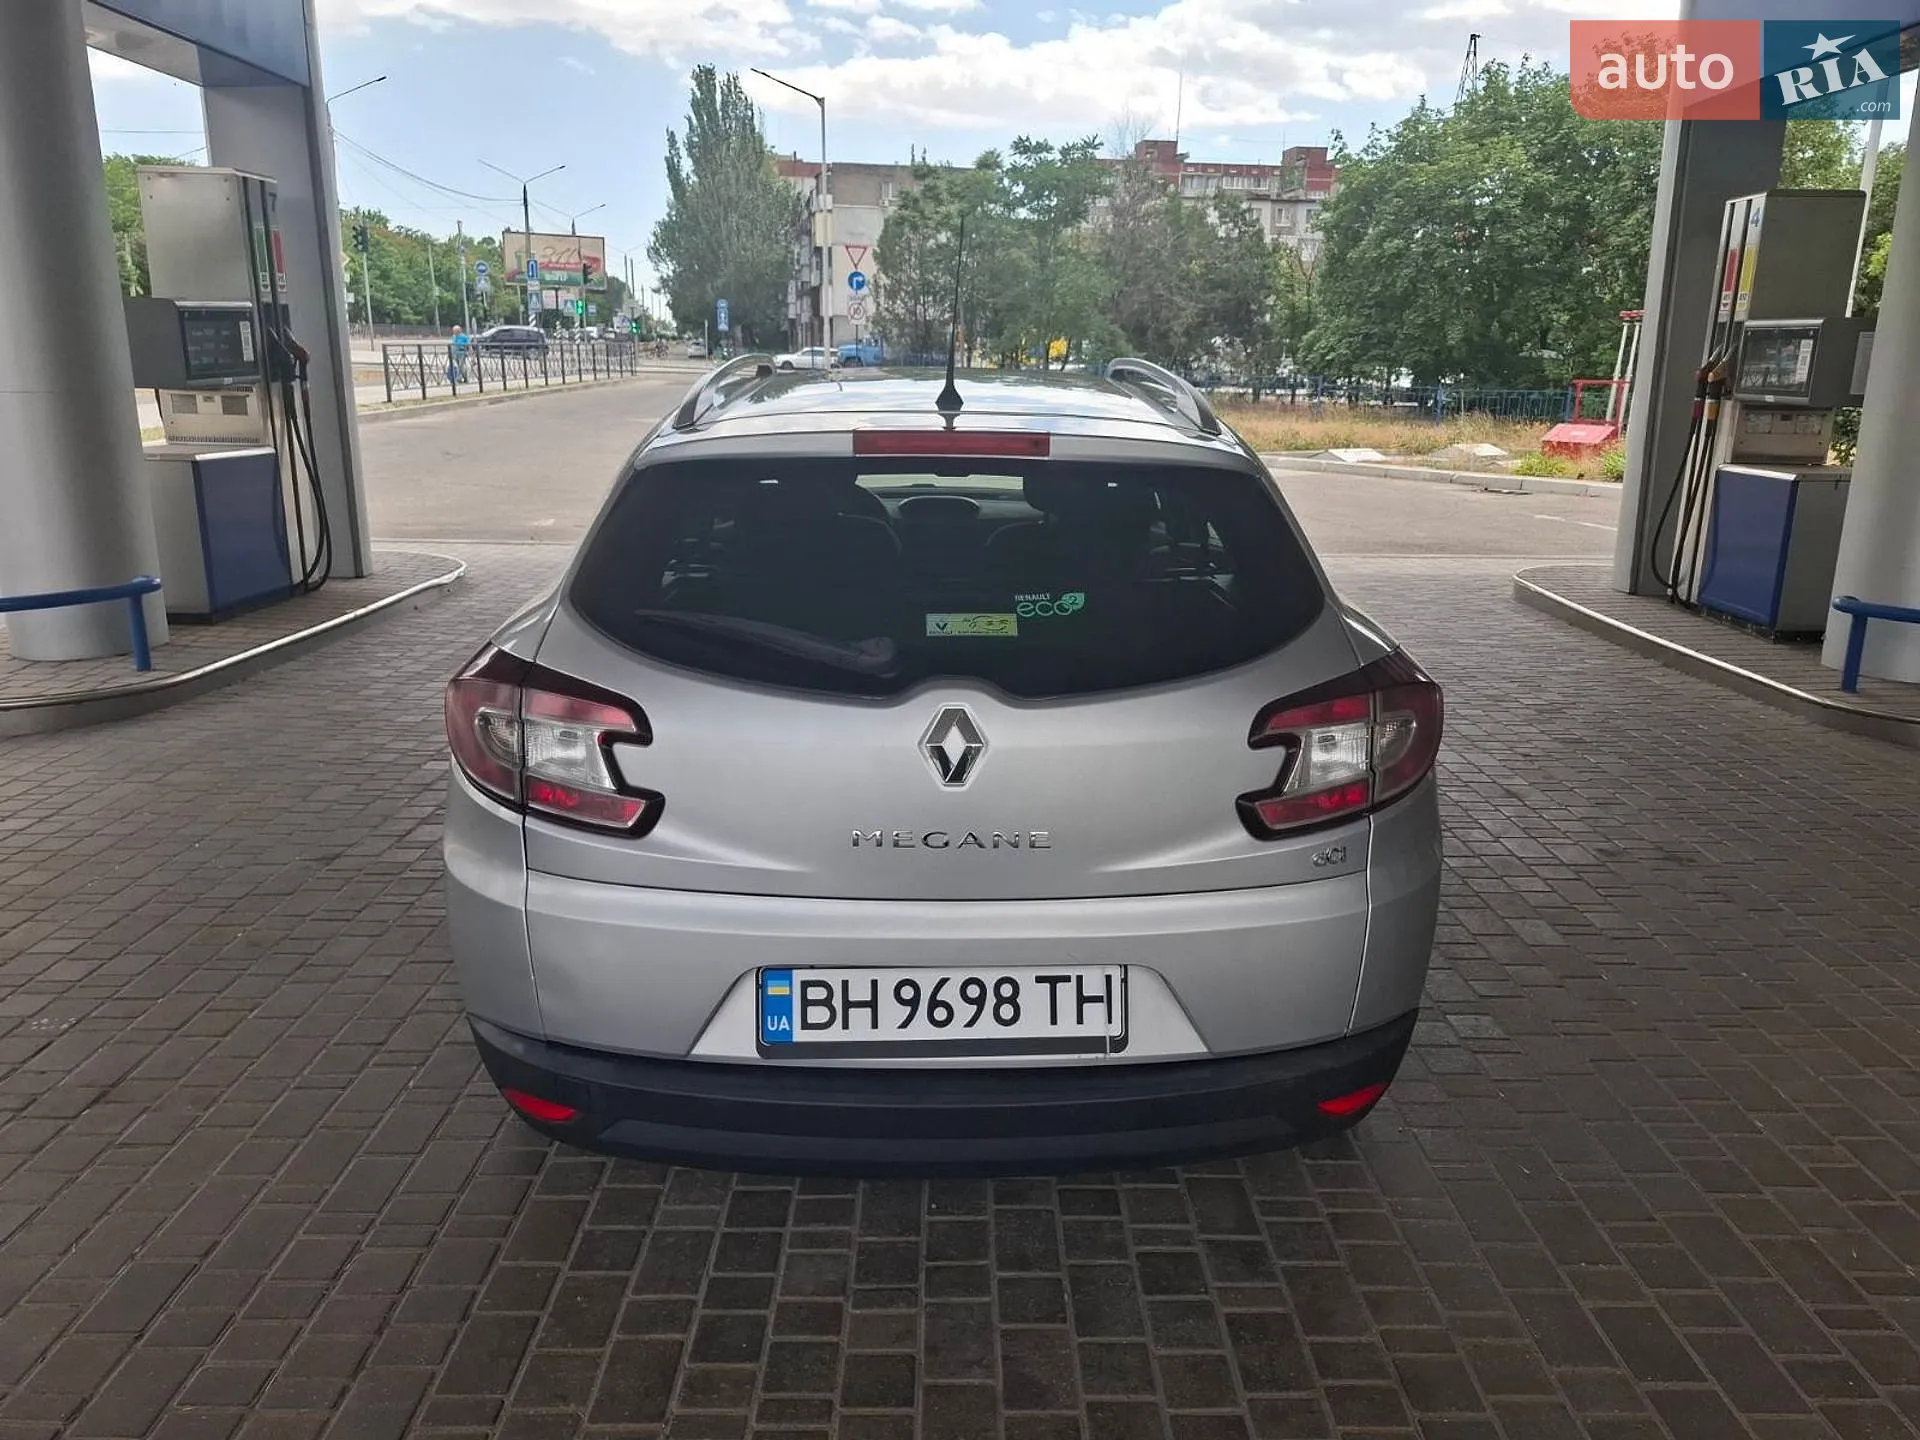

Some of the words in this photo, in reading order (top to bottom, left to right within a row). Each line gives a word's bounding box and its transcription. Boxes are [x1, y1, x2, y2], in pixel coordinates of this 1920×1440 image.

[1750, 207, 1761, 228] 4
[851, 829, 1052, 850] MEGANE
[767, 1015, 790, 1031] UA
[800, 979, 879, 1031] BH
[893, 976, 1021, 1030] 9698
[1034, 974, 1113, 1026] TH
